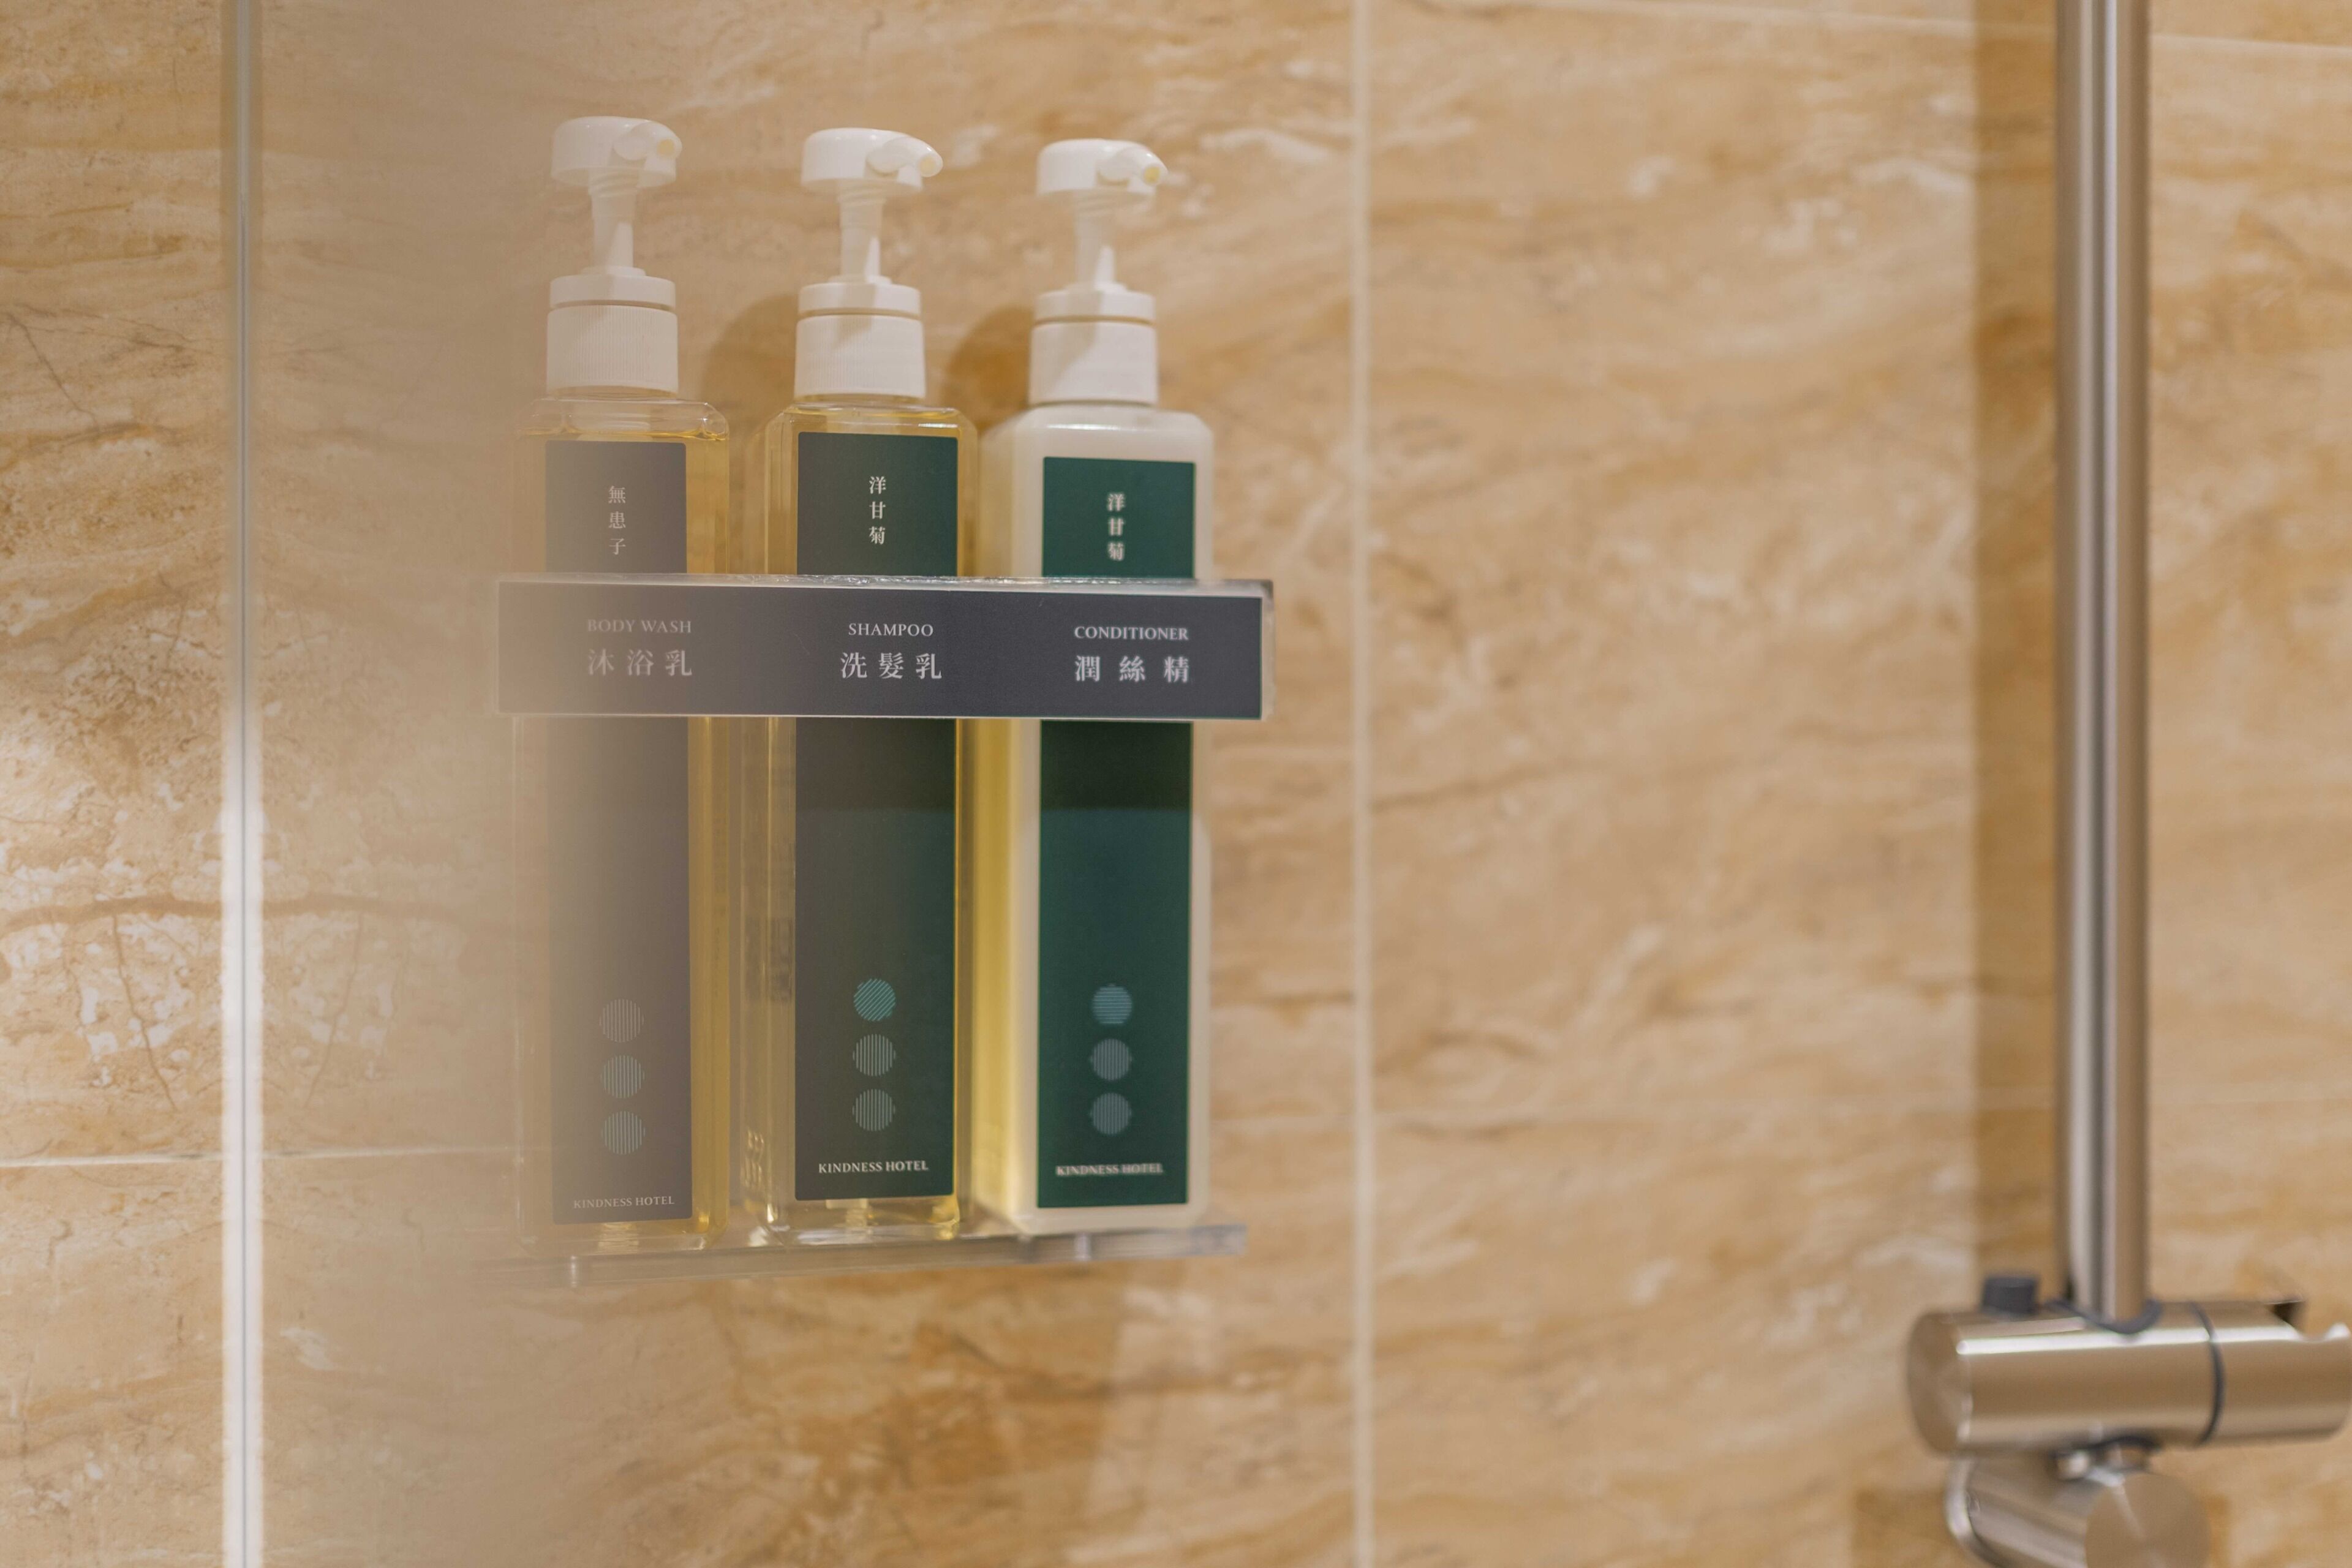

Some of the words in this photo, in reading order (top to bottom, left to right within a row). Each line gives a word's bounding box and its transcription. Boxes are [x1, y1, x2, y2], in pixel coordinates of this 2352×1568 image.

[608, 485, 626, 556] 無患子
[869, 475, 886, 545] 洋甘菊
[1107, 493, 1125, 562] 洋甘菊
[587, 619, 635, 633] BODY
[641, 620, 692, 633] WASH
[848, 622, 934, 637] SHAMPOO
[1074, 625, 1189, 641] CONDITIONER
[587, 648, 693, 677] 沐浴乳
[840, 651, 942, 680] 洗髮乳
[1074, 655, 1189, 684] 潤絲精
[819, 1162, 883, 1174] KINDNESS
[886, 1161, 928, 1172] HOTEL
[1056, 1165, 1119, 1176] KINDNESS
[1122, 1163, 1163, 1174] HOTEL
[573, 1197, 633, 1209] KINDNESS
[636, 1196, 675, 1207] HOTEL
